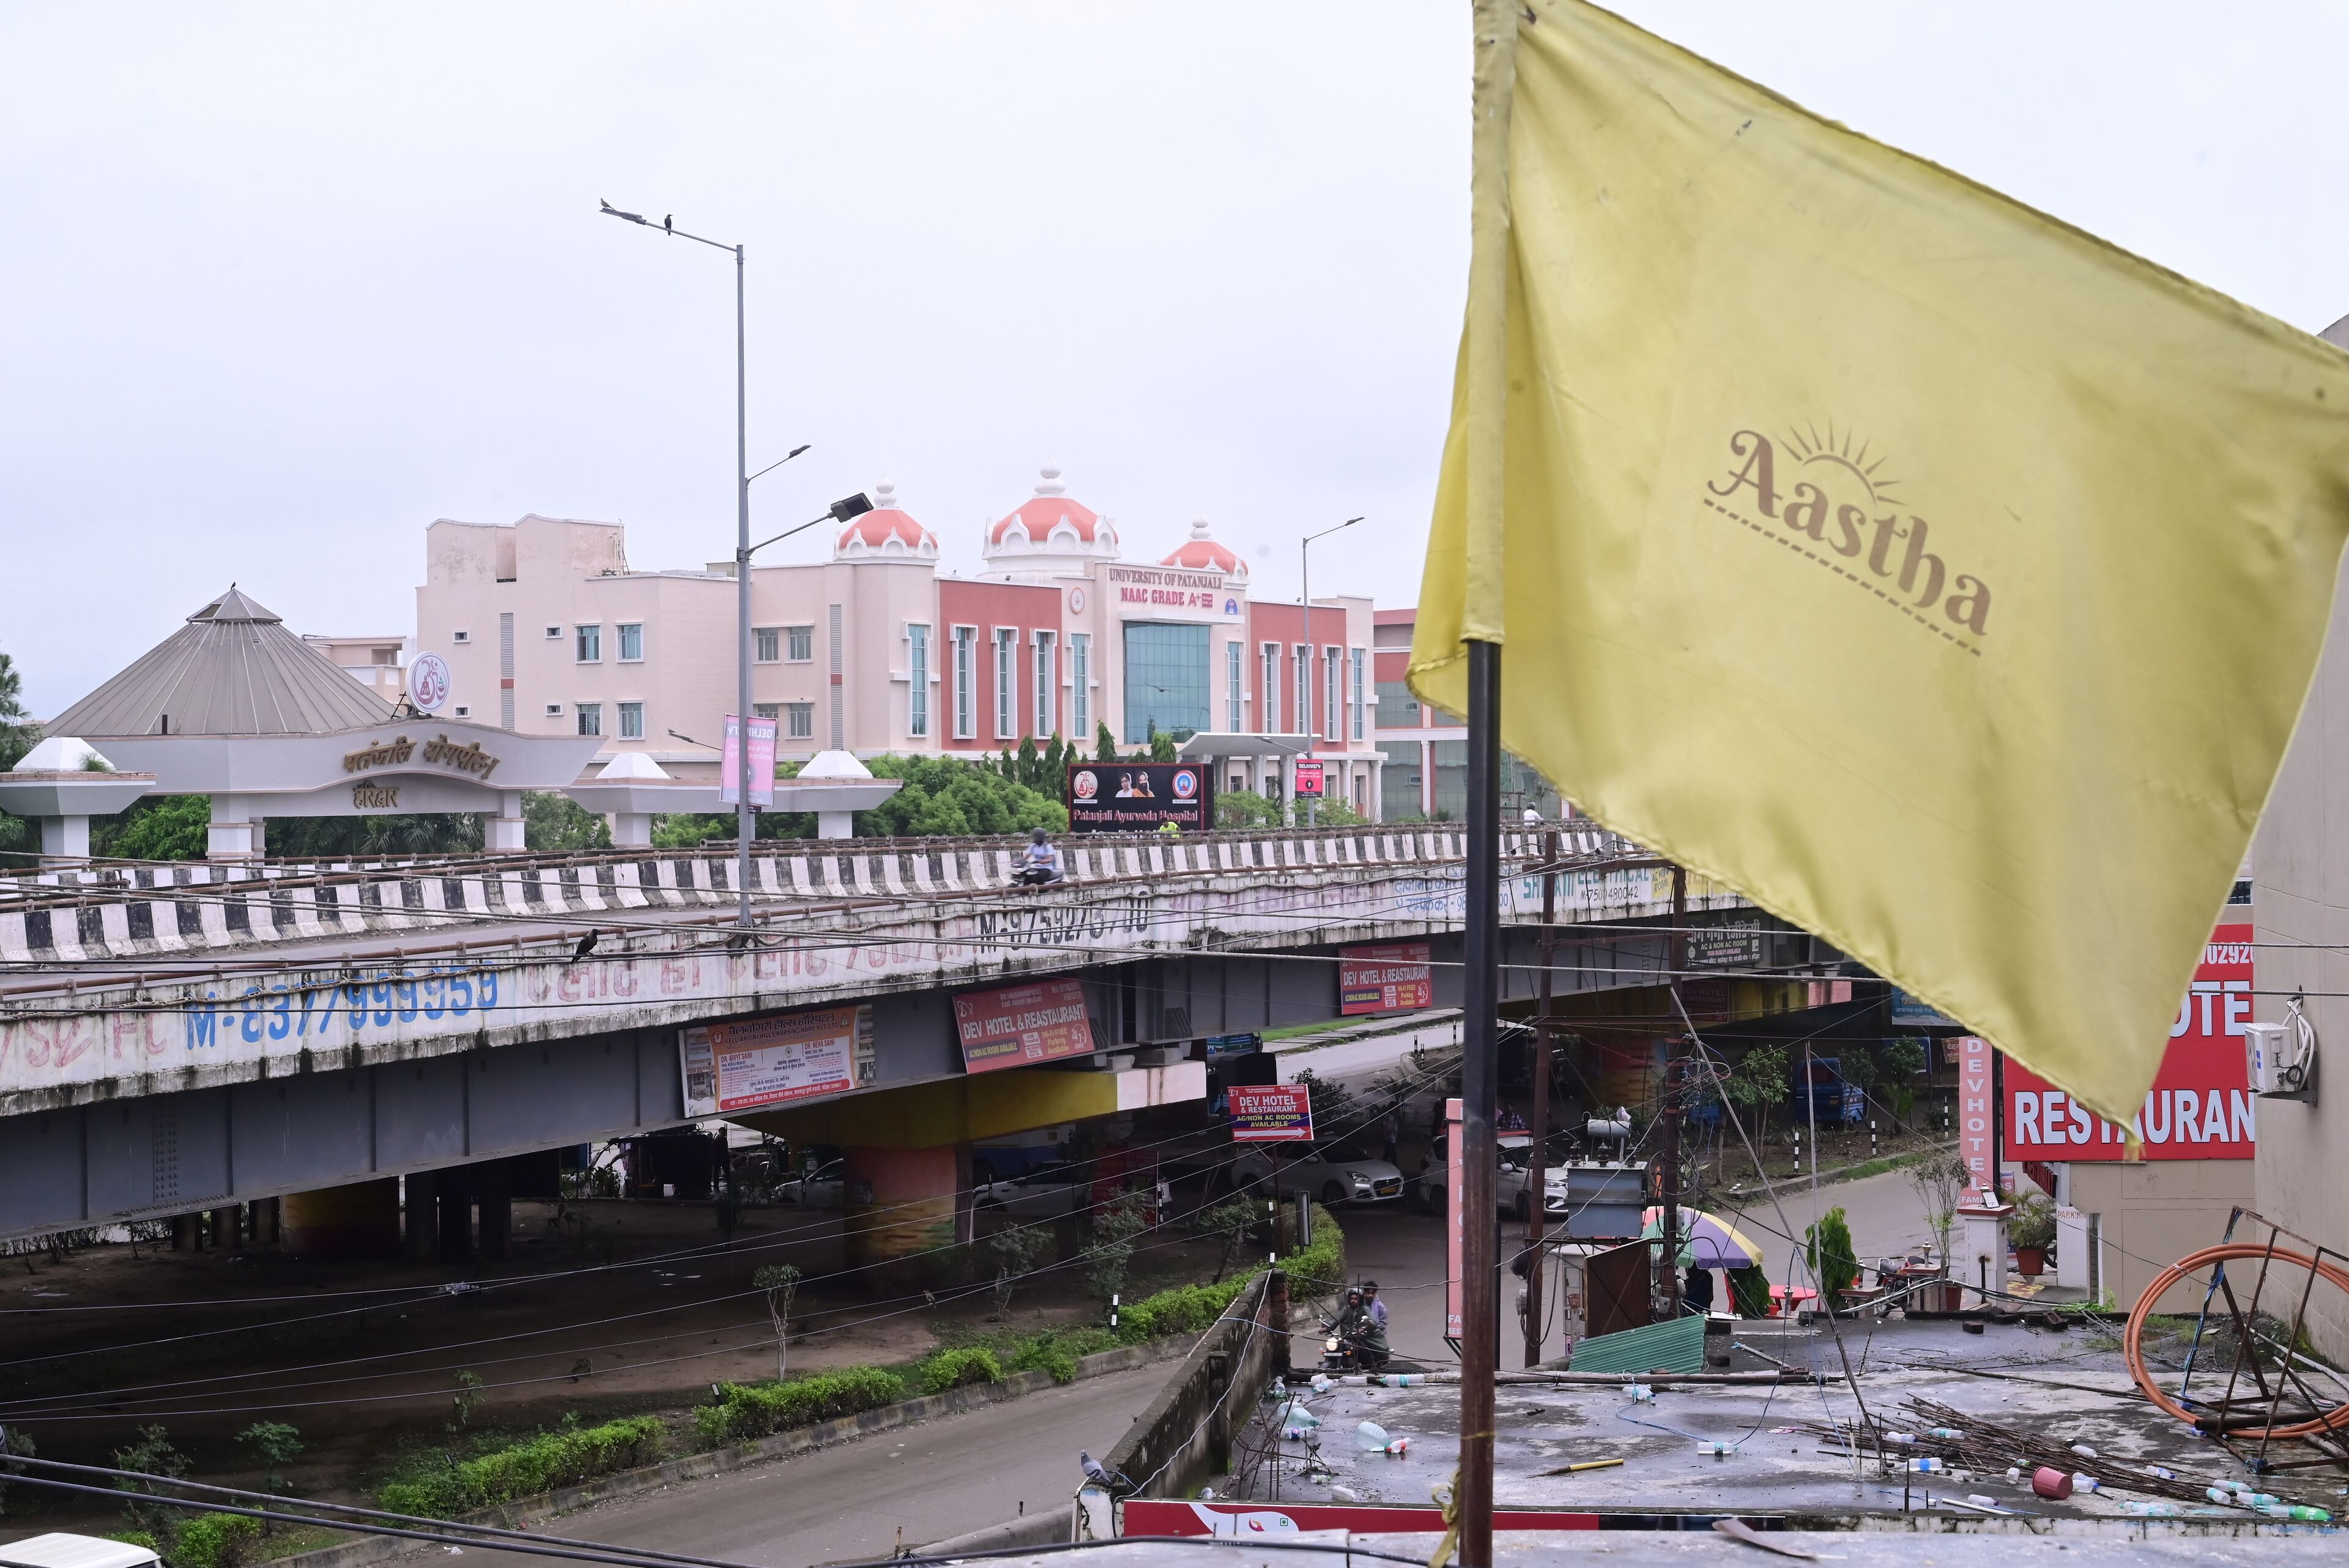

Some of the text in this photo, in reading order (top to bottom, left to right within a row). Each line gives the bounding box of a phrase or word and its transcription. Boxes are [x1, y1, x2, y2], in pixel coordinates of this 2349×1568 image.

[1707, 429, 1992, 636] Aastha
[1109, 568, 1222, 589] UNIVERSITY OF PATANJALI
[1121, 587, 1201, 606] NAAC GRADE A+
[343, 734, 418, 773] पतंजलि
[352, 779, 401, 809] हरिद्वार
[1073, 809, 1198, 824] Patanjali Ayurveda Hospital
[1344, 965, 1430, 986] DEV HOTEL & REASTAURANT
[963, 1003, 1085, 1039] DEV HOTEL & REASTAURANT
[724, 1034, 759, 1044] VELLIANGIRI
[776, 1028, 800, 1036] NURSING
[1047, 1038, 1066, 1046] Parking
[1239, 1095, 1297, 1107] DEV HOTEL
